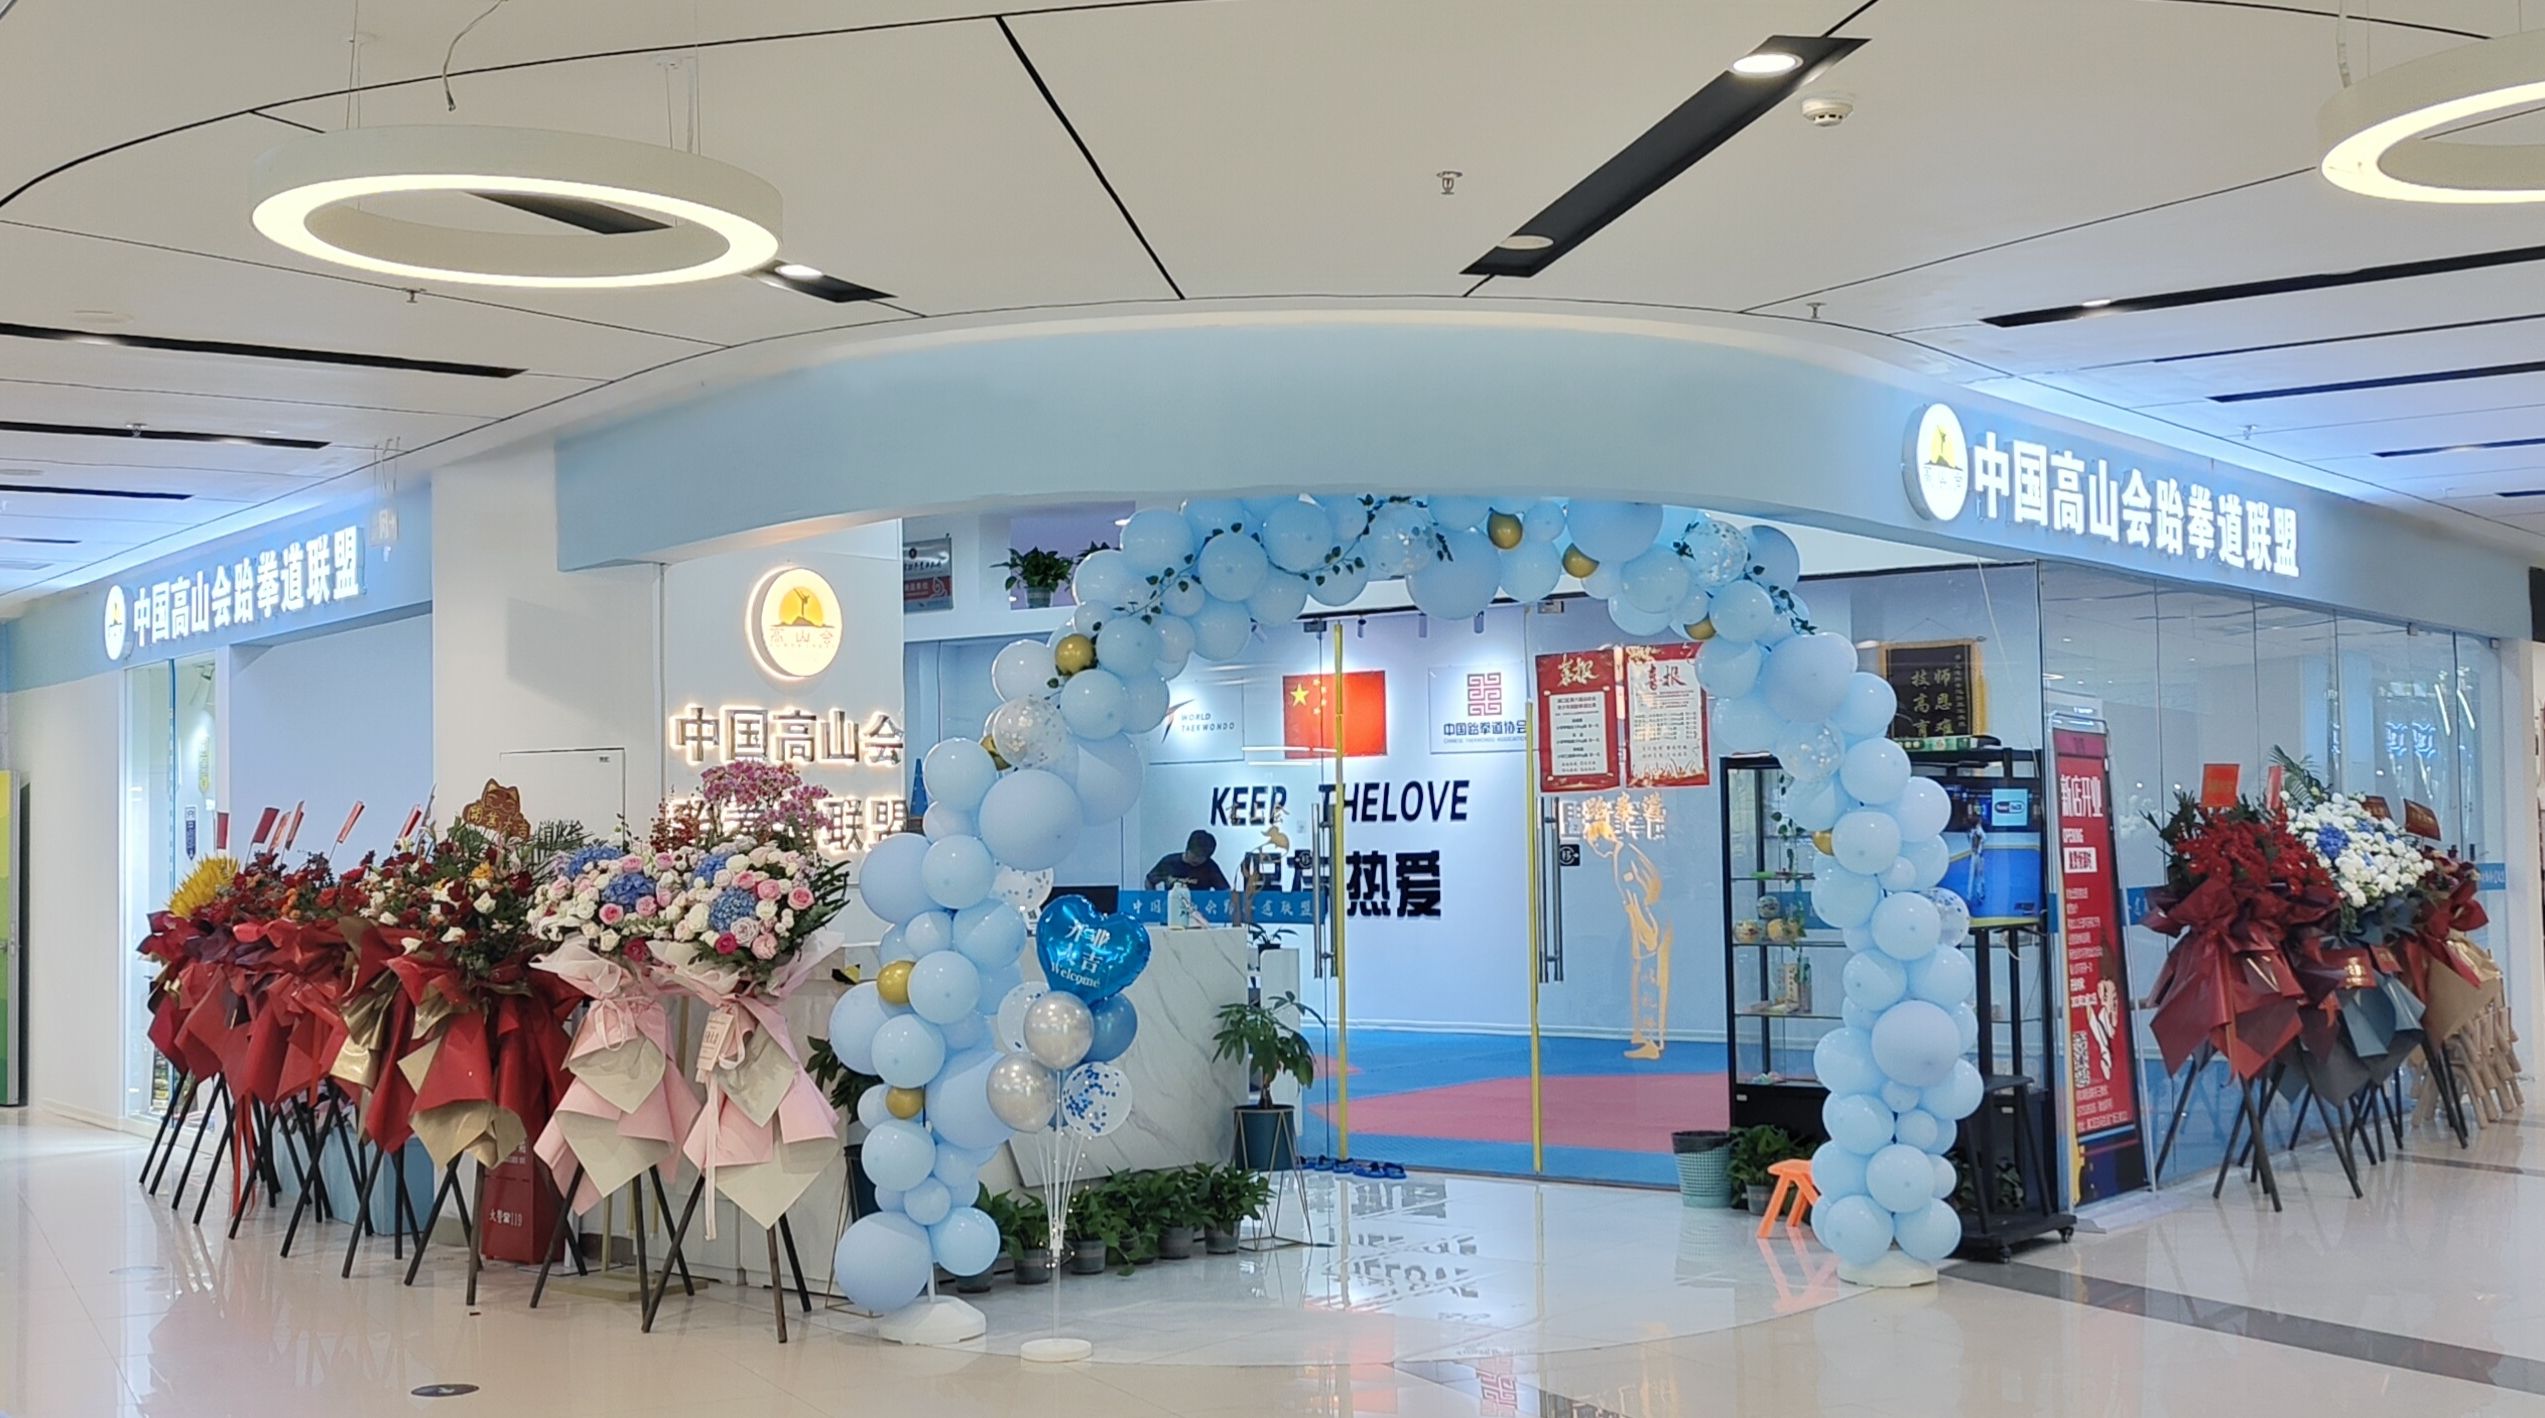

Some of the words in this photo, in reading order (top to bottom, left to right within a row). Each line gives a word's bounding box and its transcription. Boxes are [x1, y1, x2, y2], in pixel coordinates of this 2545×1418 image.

[1974, 432, 2299, 577] 中国高山会跆拳道联盟
[133, 525, 359, 647] 中国高山会跆拳道联盟
[670, 704, 905, 766] 中国高山会
[1181, 712, 1212, 721] WORLD
[1181, 722, 1236, 733] TAEKWONDO
[1443, 719, 1528, 737] 中国跆拳道协会
[1210, 785, 1287, 827] KEEP
[2060, 774, 2104, 818] 新店开业
[1050, 959, 1101, 988] Welcome
